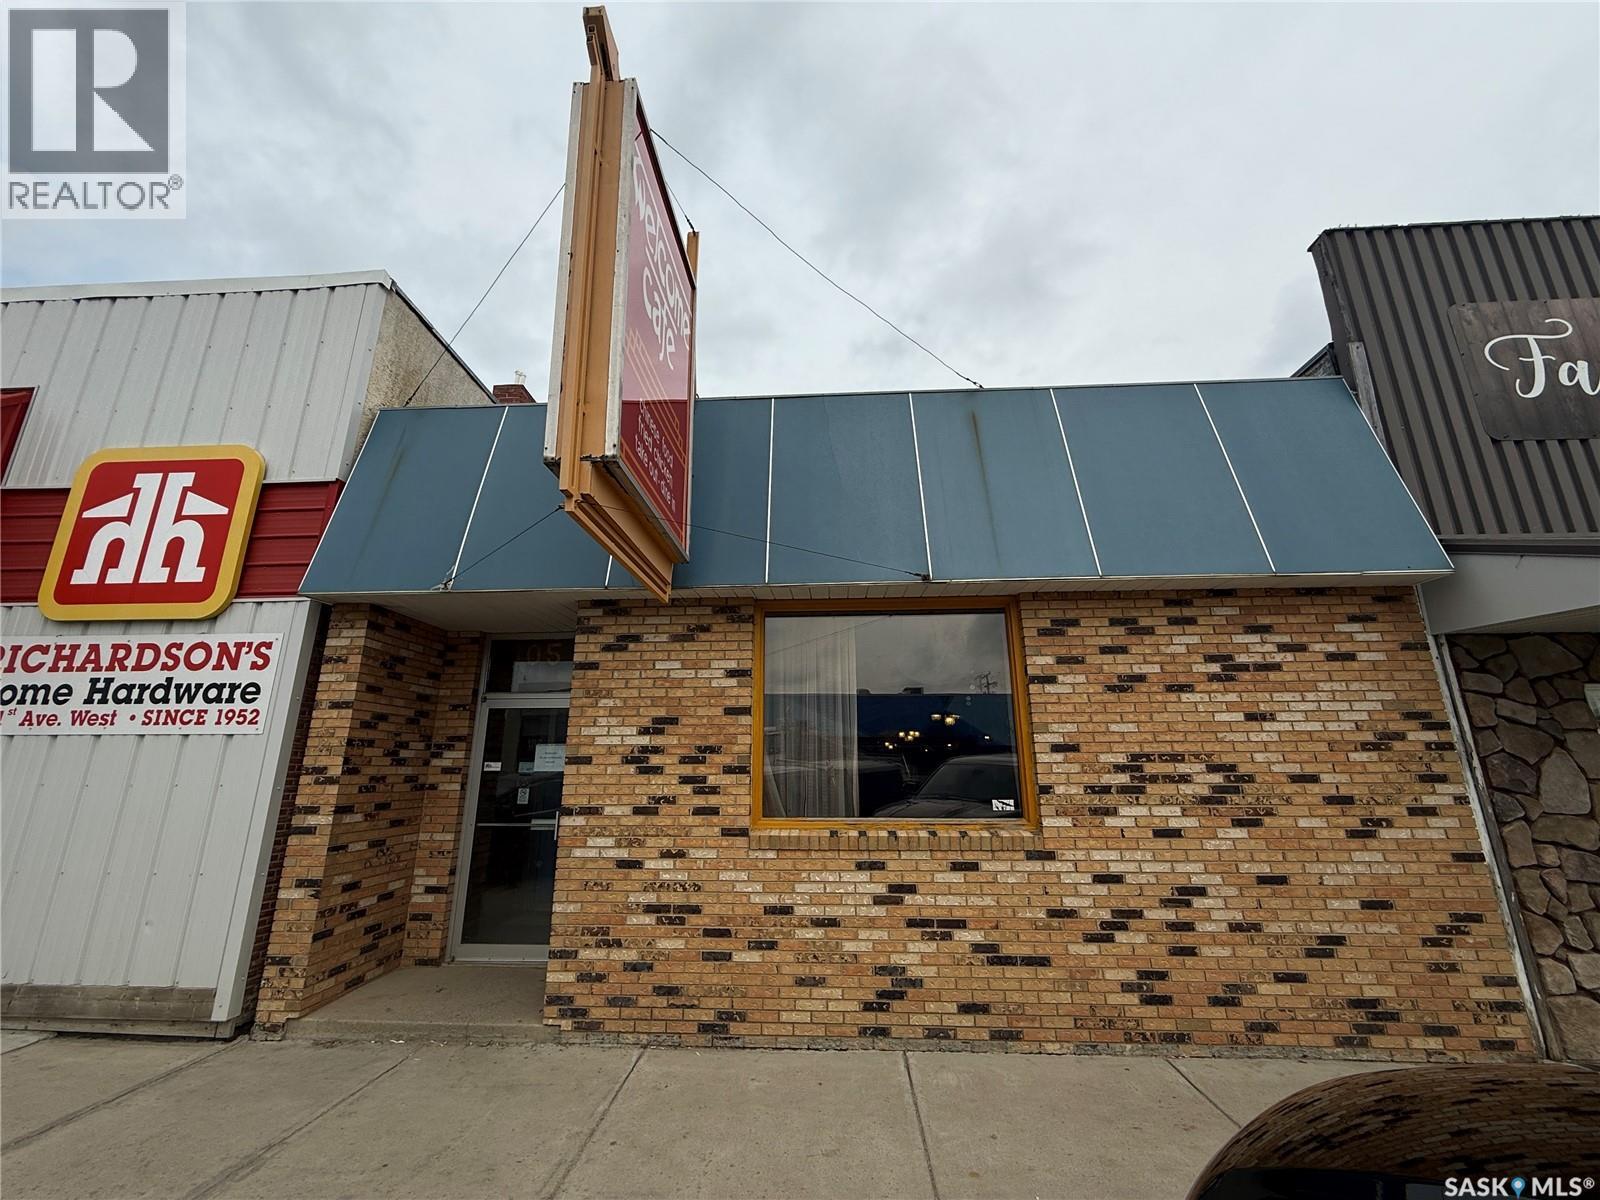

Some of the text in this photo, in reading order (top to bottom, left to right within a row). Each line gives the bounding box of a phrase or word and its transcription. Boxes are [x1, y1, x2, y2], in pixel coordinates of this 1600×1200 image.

[0, 641, 274, 674] ICHARDSON'S
[0, 676, 262, 706] ome Hardware
[18, 711, 62, 727] Ave.
[70, 709, 118, 727] West
[141, 708, 208, 726] SINCE
[214, 708, 261, 726] 1952
